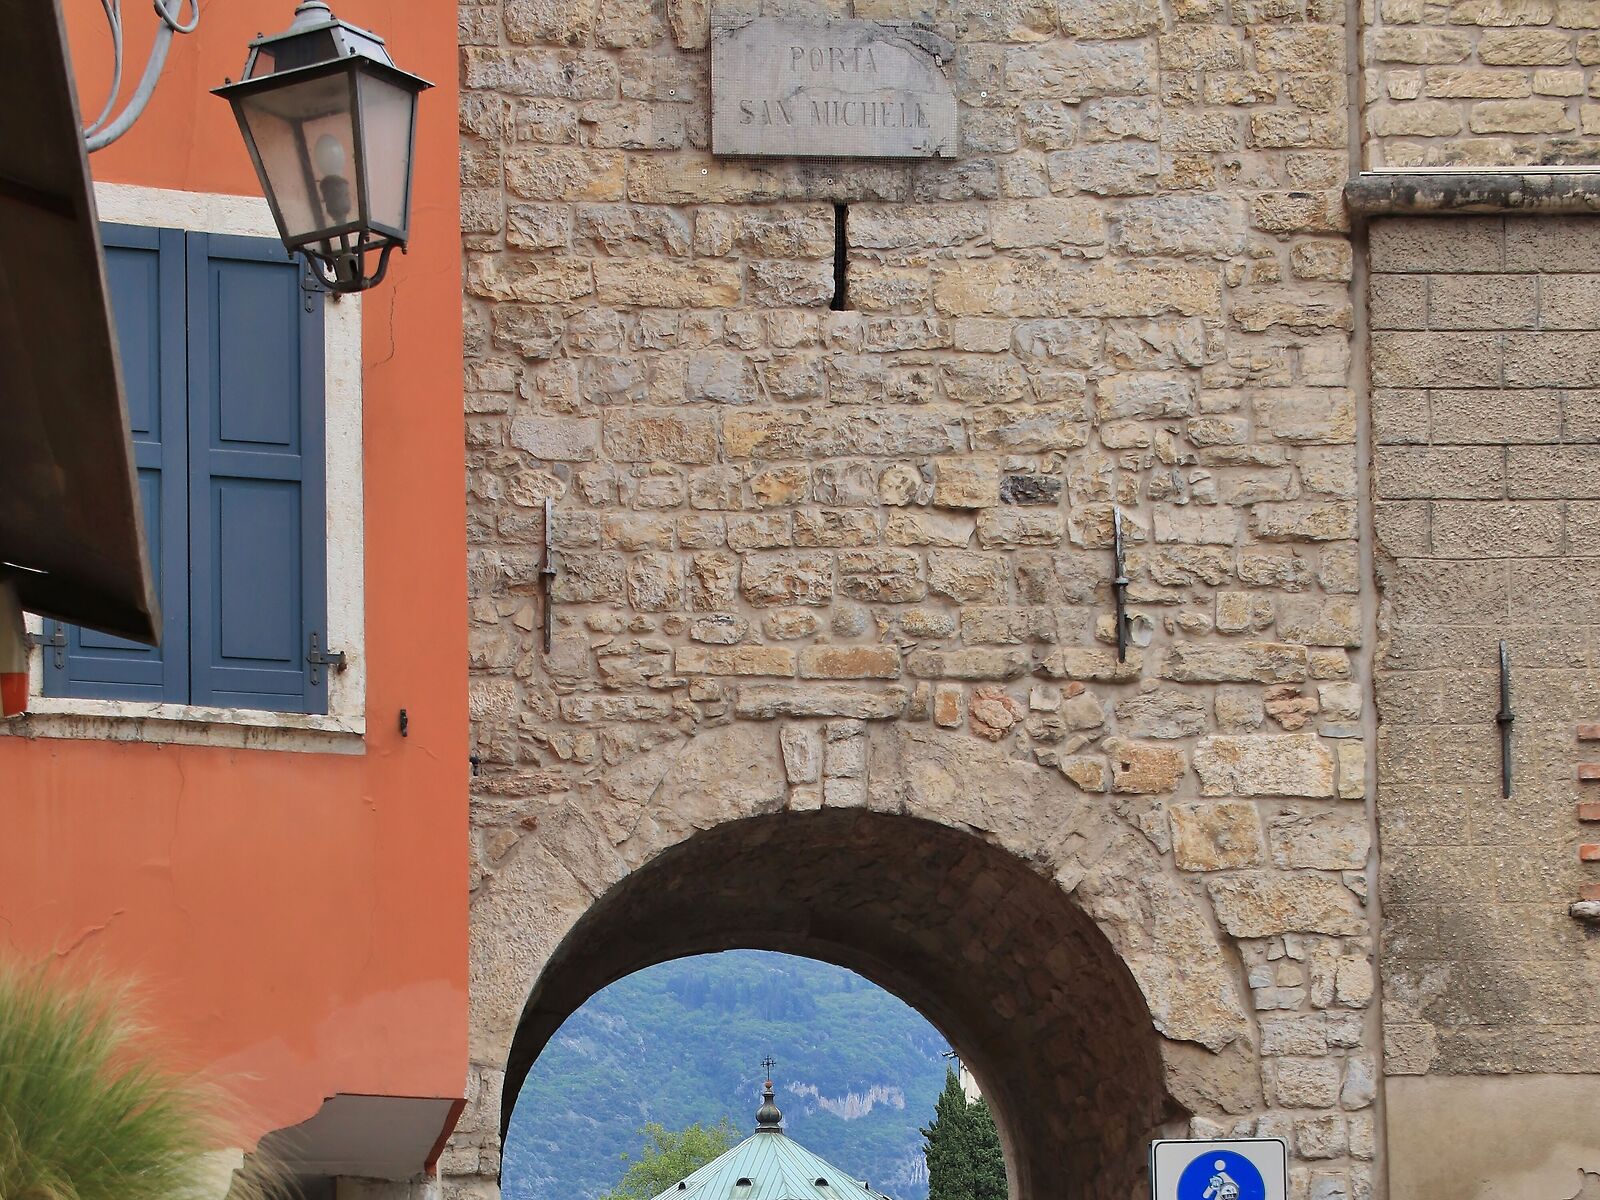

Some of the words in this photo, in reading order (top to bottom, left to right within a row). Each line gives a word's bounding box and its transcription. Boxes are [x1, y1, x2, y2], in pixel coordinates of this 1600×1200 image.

[789, 46, 879, 74] PORTA
[738, 99, 793, 127] SAN
[810, 100, 931, 129] MICHELE
